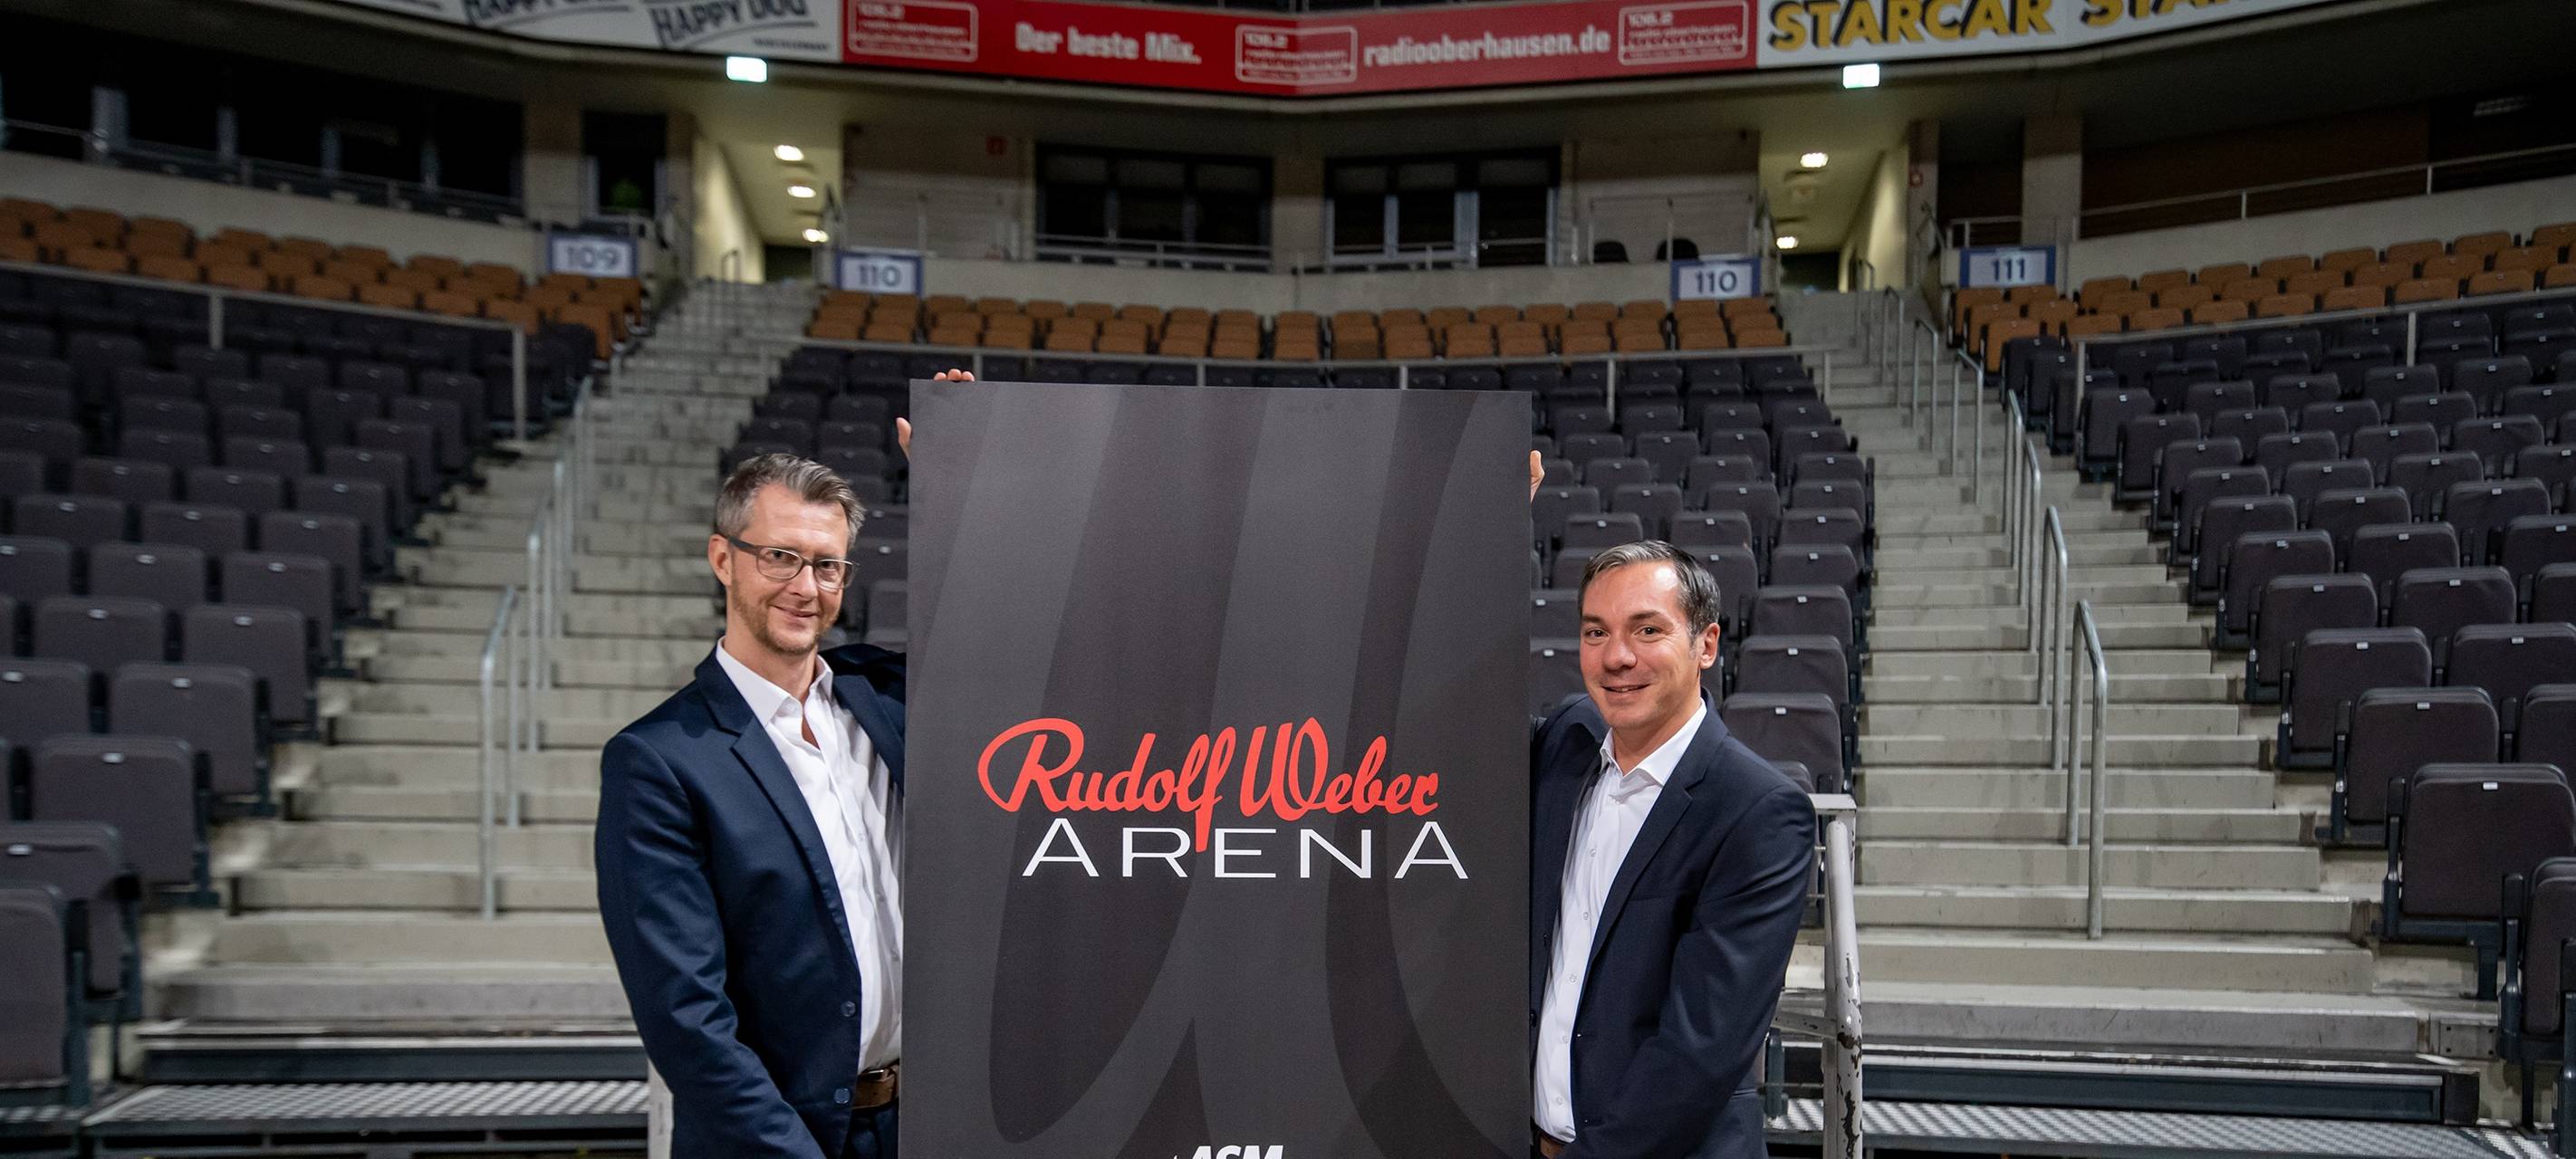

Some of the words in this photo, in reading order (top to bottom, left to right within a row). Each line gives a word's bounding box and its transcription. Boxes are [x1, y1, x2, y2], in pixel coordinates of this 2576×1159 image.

[649, 1, 741, 49] HAPPY
[1014, 21, 1063, 53] Der
[1067, 24, 1139, 60] beste
[1145, 31, 1203, 65] Mix.
[1363, 24, 1611, 67] radiooberhausen.de
[1768, 0, 2055, 52] STARCAR
[567, 245, 619, 268] 109
[858, 263, 900, 287] 110
[1992, 259, 2025, 282] 111
[1696, 271, 1737, 292] 110
[977, 717, 1236, 853] Rudolf
[1240, 717, 1439, 821] Weber
[1022, 818, 1468, 879] ARENA
